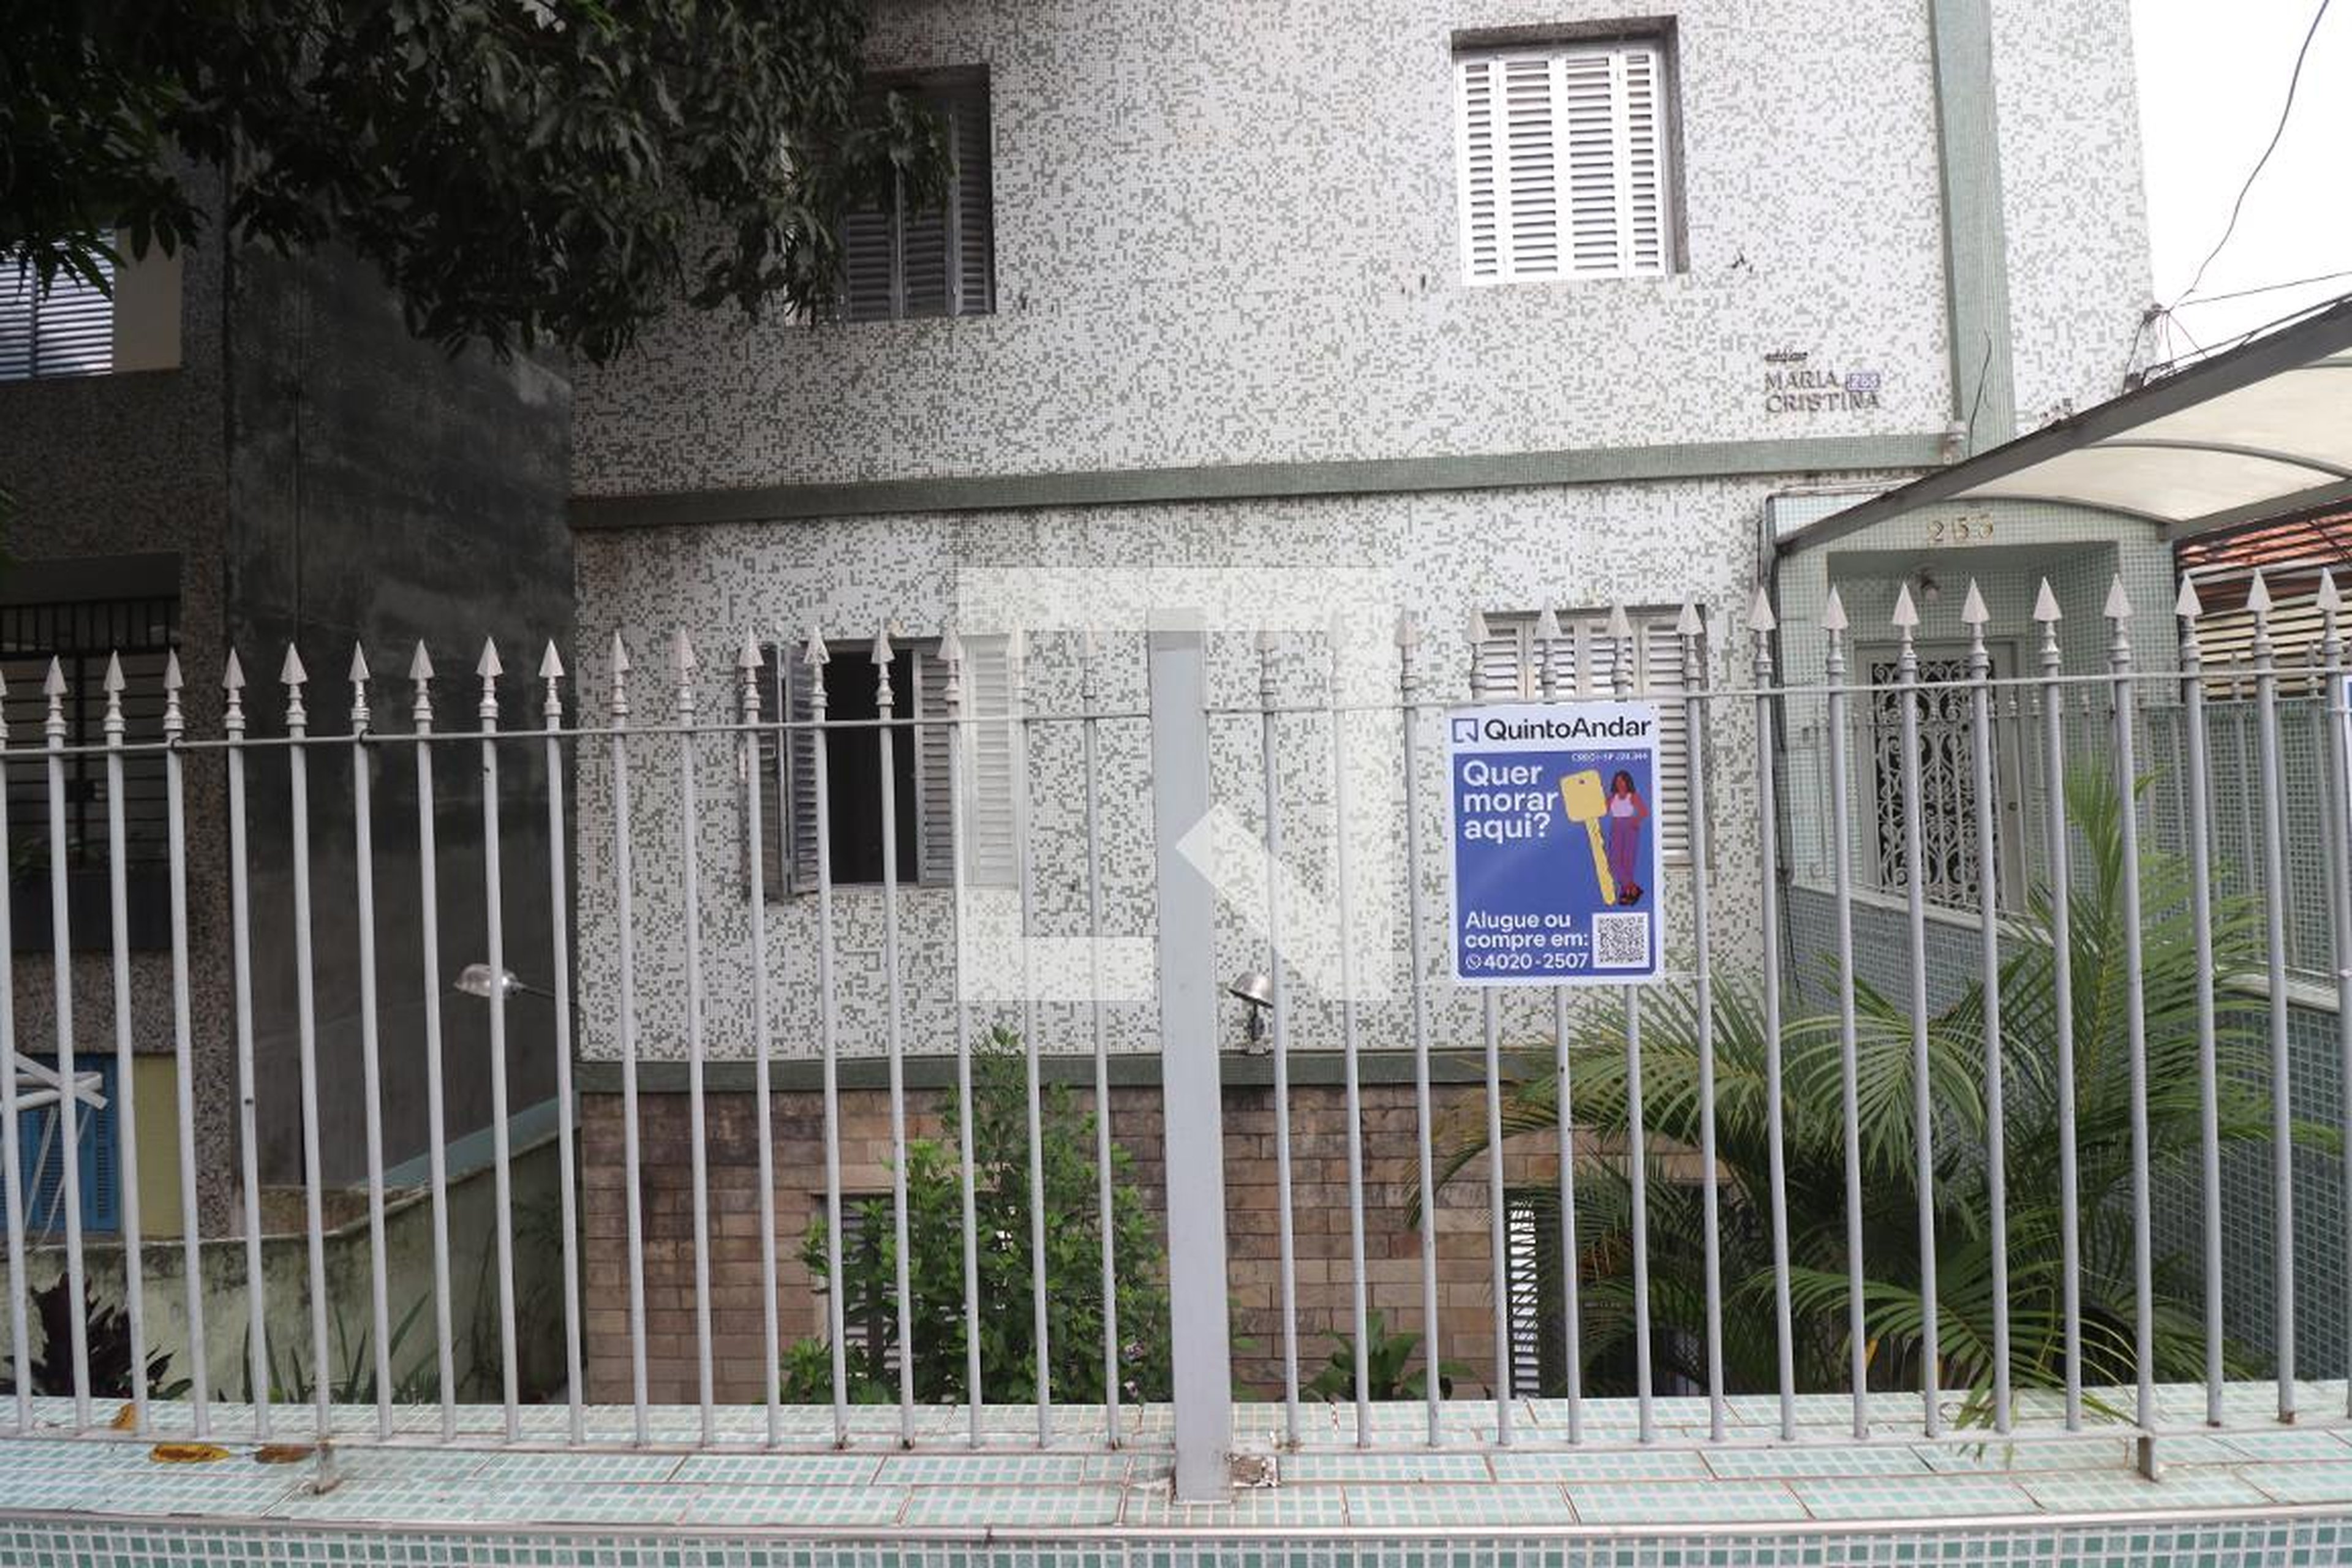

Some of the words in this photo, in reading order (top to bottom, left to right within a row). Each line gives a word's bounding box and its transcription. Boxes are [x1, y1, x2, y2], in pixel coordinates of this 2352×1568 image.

[1765, 370, 1840, 390] MARIA
[1765, 391, 1880, 413] CRISTINA
[1484, 717, 1652, 740] QuintoAndar
[1463, 760, 1543, 787] Quer
[1463, 791, 1559, 813] morar
[1464, 812, 1551, 844] aqui?
[1464, 910, 1540, 932] Alugue
[1544, 914, 1571, 928] ou
[1464, 933, 1546, 951] compre
[1551, 933, 1588, 947] em:
